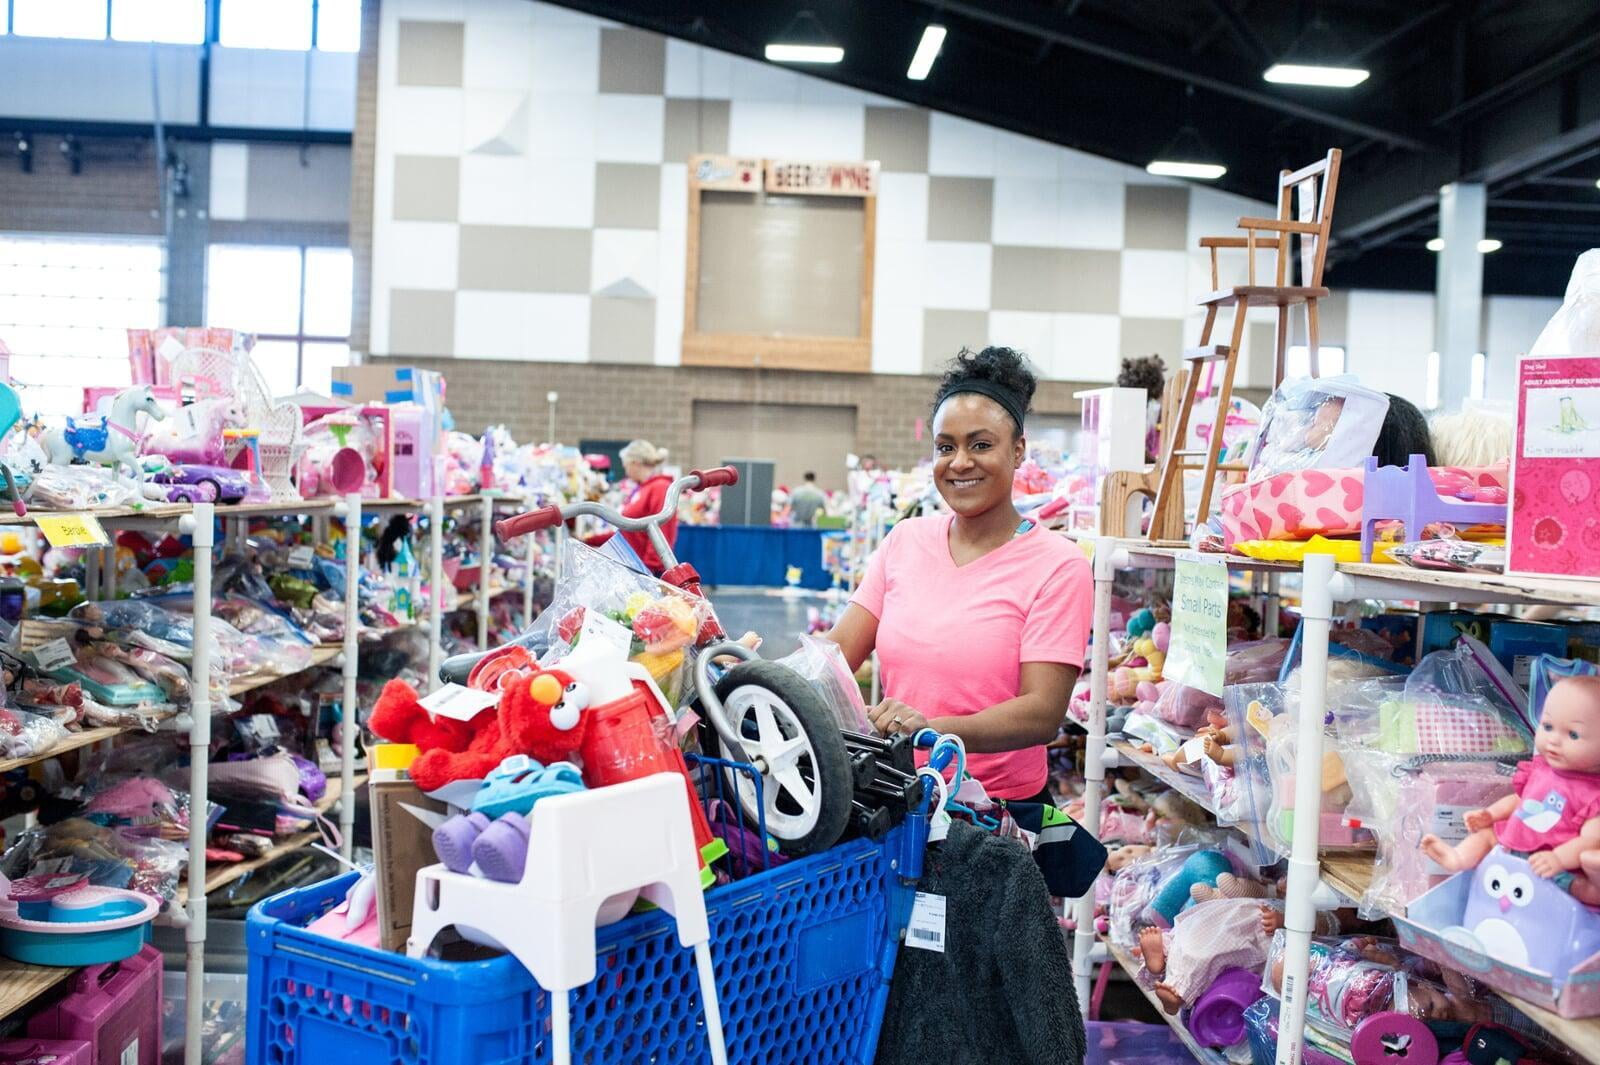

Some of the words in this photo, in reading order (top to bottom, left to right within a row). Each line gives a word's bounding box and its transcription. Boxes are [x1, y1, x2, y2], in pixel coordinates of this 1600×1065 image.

[776, 163, 810, 187] BEER
[1544, 378, 1576, 386] ASSEMBLY
[1181, 593, 1201, 613] Small
[1203, 598, 1222, 619] Parts
